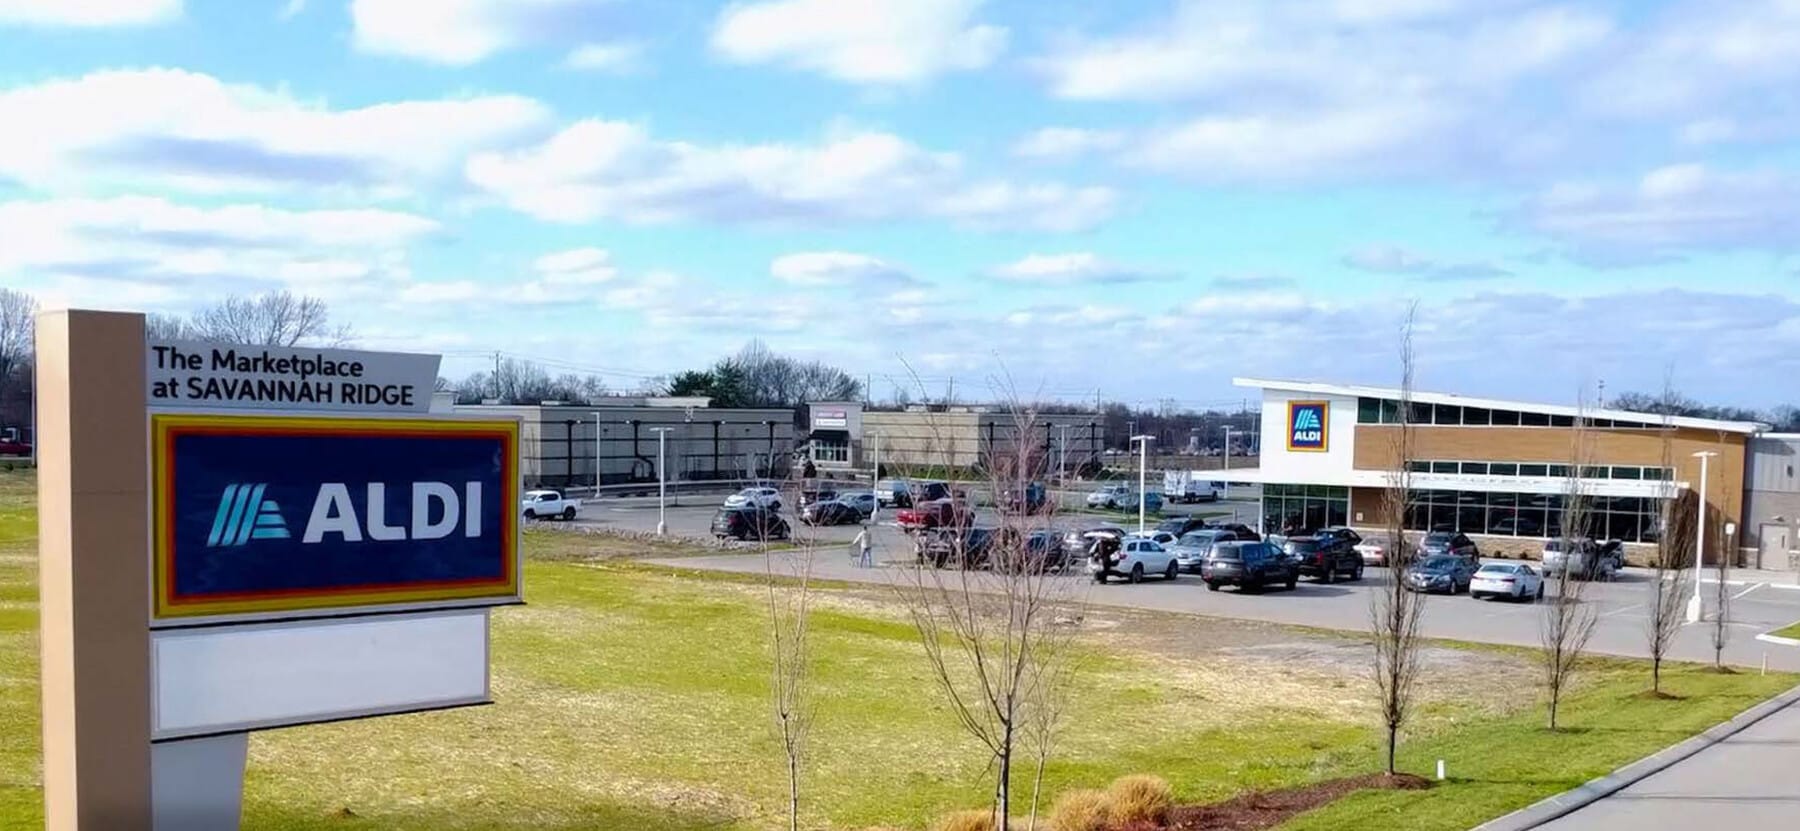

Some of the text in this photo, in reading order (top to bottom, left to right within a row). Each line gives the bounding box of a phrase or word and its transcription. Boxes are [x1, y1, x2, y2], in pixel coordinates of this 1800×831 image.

[152, 346, 364, 380] The Marketplace
[152, 377, 415, 406] at SAVANNAH RIDGE
[1294, 431, 1321, 441] ALDI
[302, 481, 482, 543] ALDI
